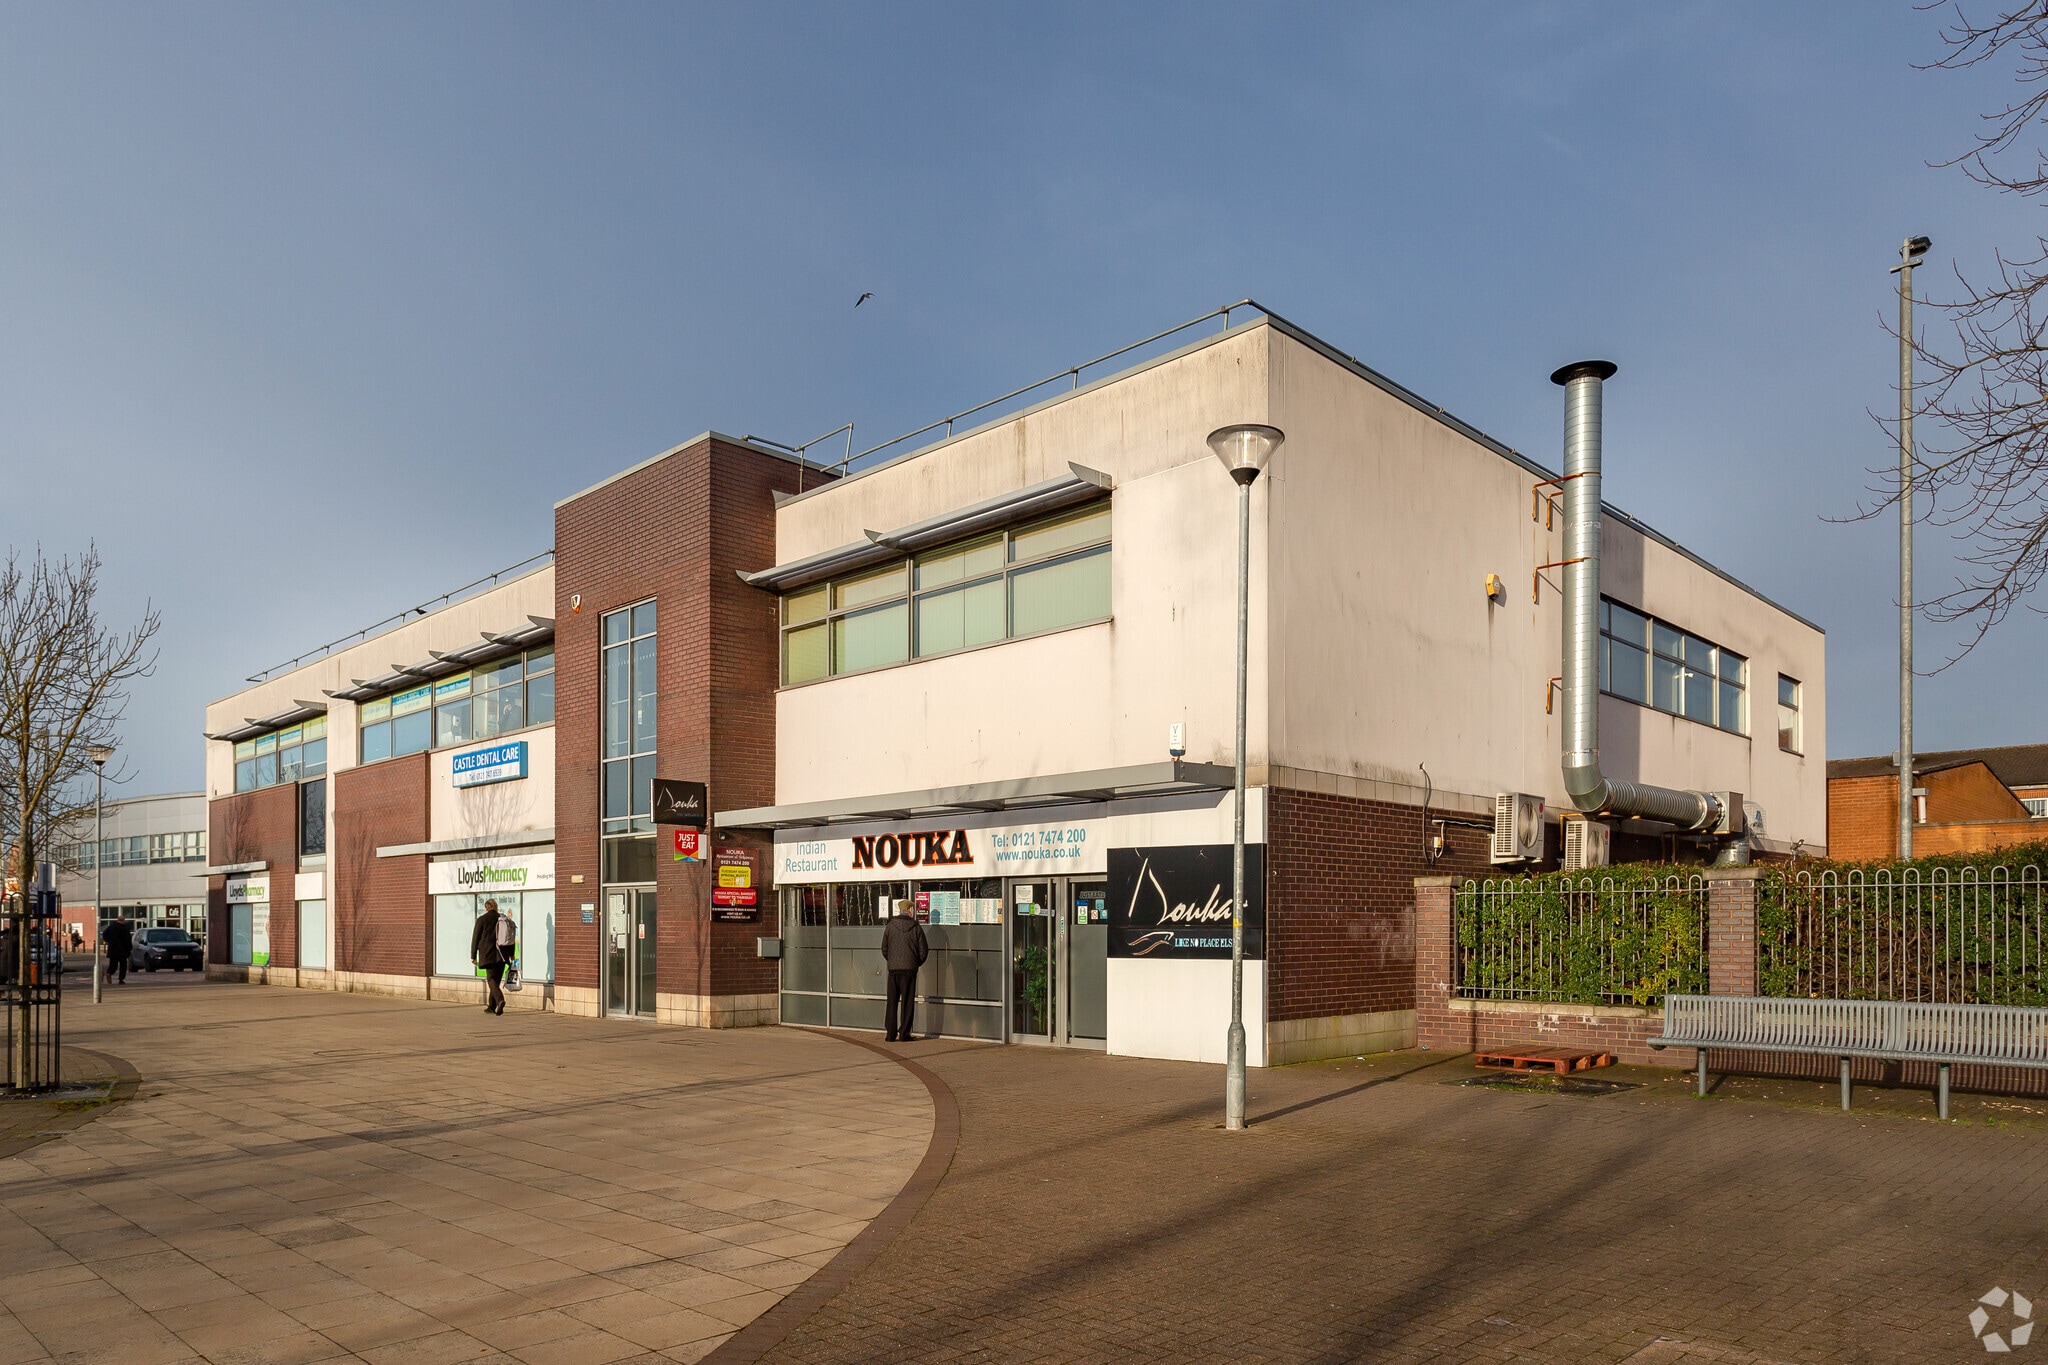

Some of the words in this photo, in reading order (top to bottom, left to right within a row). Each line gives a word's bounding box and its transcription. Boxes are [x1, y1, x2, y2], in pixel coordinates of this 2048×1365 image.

[453, 755, 475, 771] CASTLE
[476, 751, 500, 766] DENTAL
[501, 746, 519, 762] CARE
[678, 833, 696, 842] JUST
[681, 841, 696, 849] EAT
[991, 834, 1009, 847] Tel:
[1011, 832, 1035, 847] 0121
[1039, 829, 1064, 845] 7474
[1066, 828, 1086, 843] 200
[796, 840, 826, 855] Indian
[852, 828, 974, 870] NOUKA
[996, 844, 1081, 861] www.nouka.co.uk
[785, 857, 838, 873] Restaurant
[458, 865, 528, 889] LloydsPharmacy
[229, 883, 265, 900] LloydsPharmacy
[1174, 937, 1190, 948] LIKE
[1190, 937, 1199, 948] NO
[1199, 937, 1220, 948] PLACE
